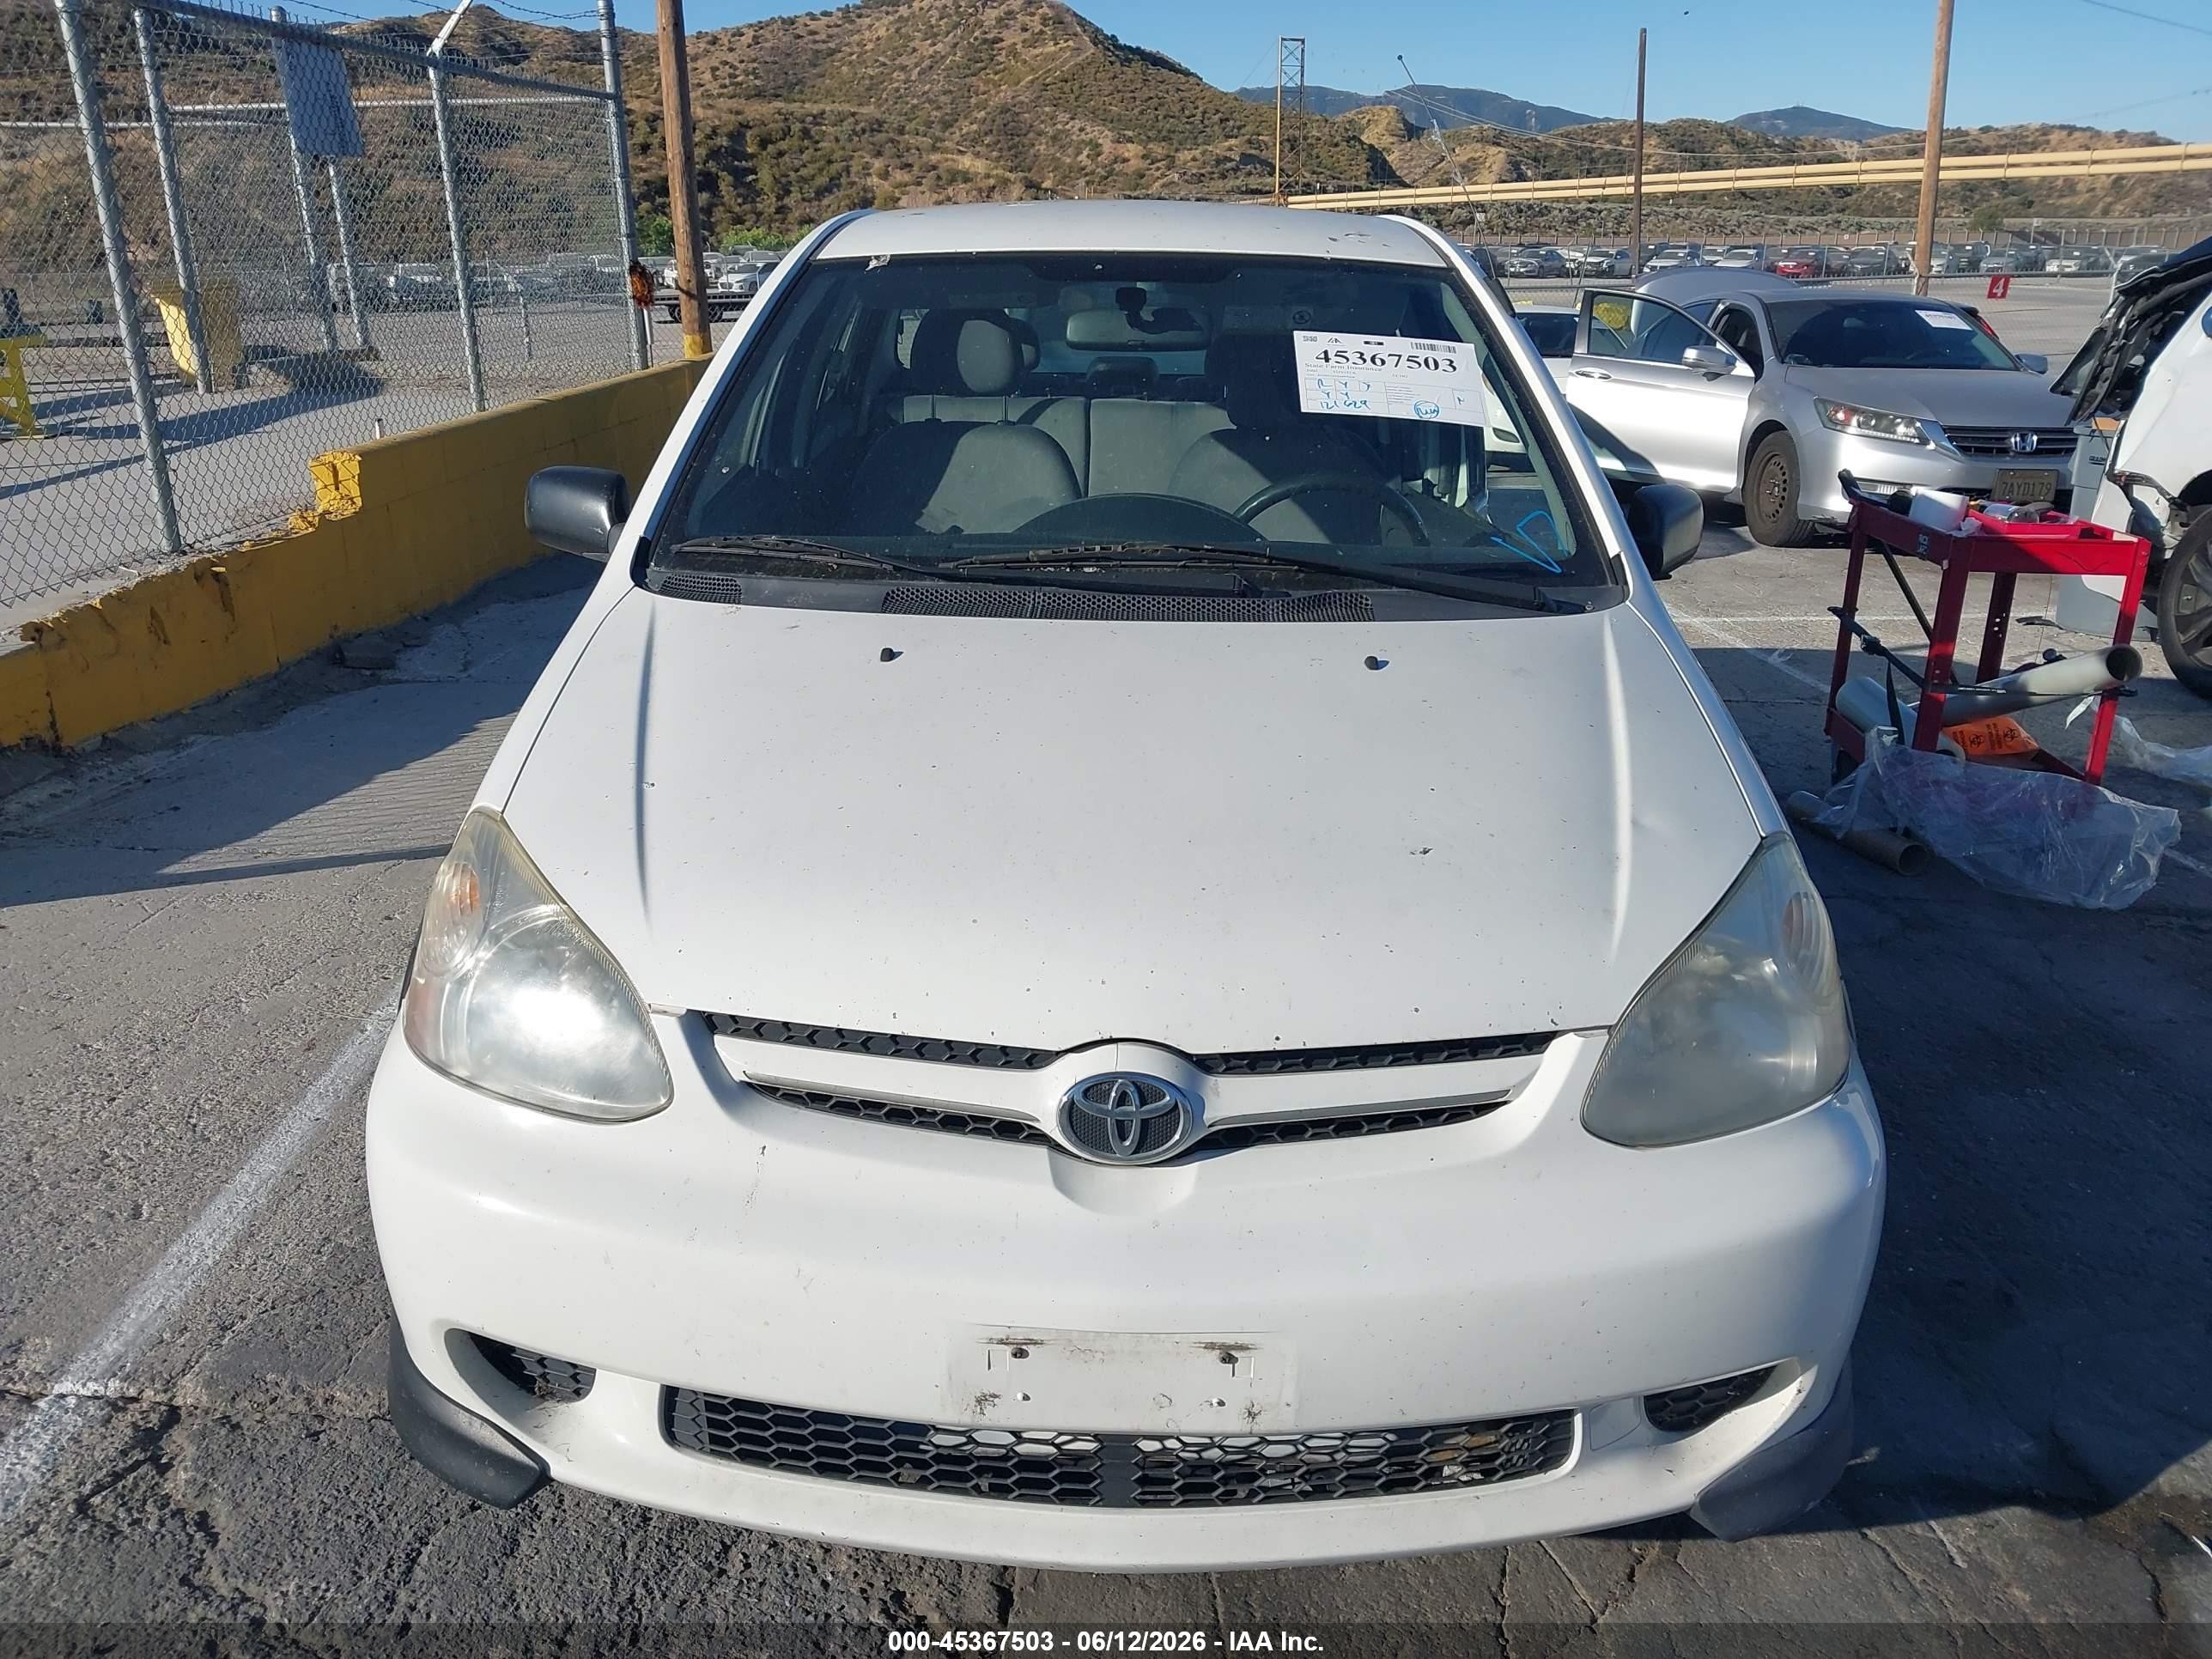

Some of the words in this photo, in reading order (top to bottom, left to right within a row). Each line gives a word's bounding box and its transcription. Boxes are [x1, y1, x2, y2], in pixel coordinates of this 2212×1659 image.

[1992, 277, 2005, 297] 4
[1315, 349, 1457, 374] 45367503
[2002, 482, 2052, 496] 7AYD179
